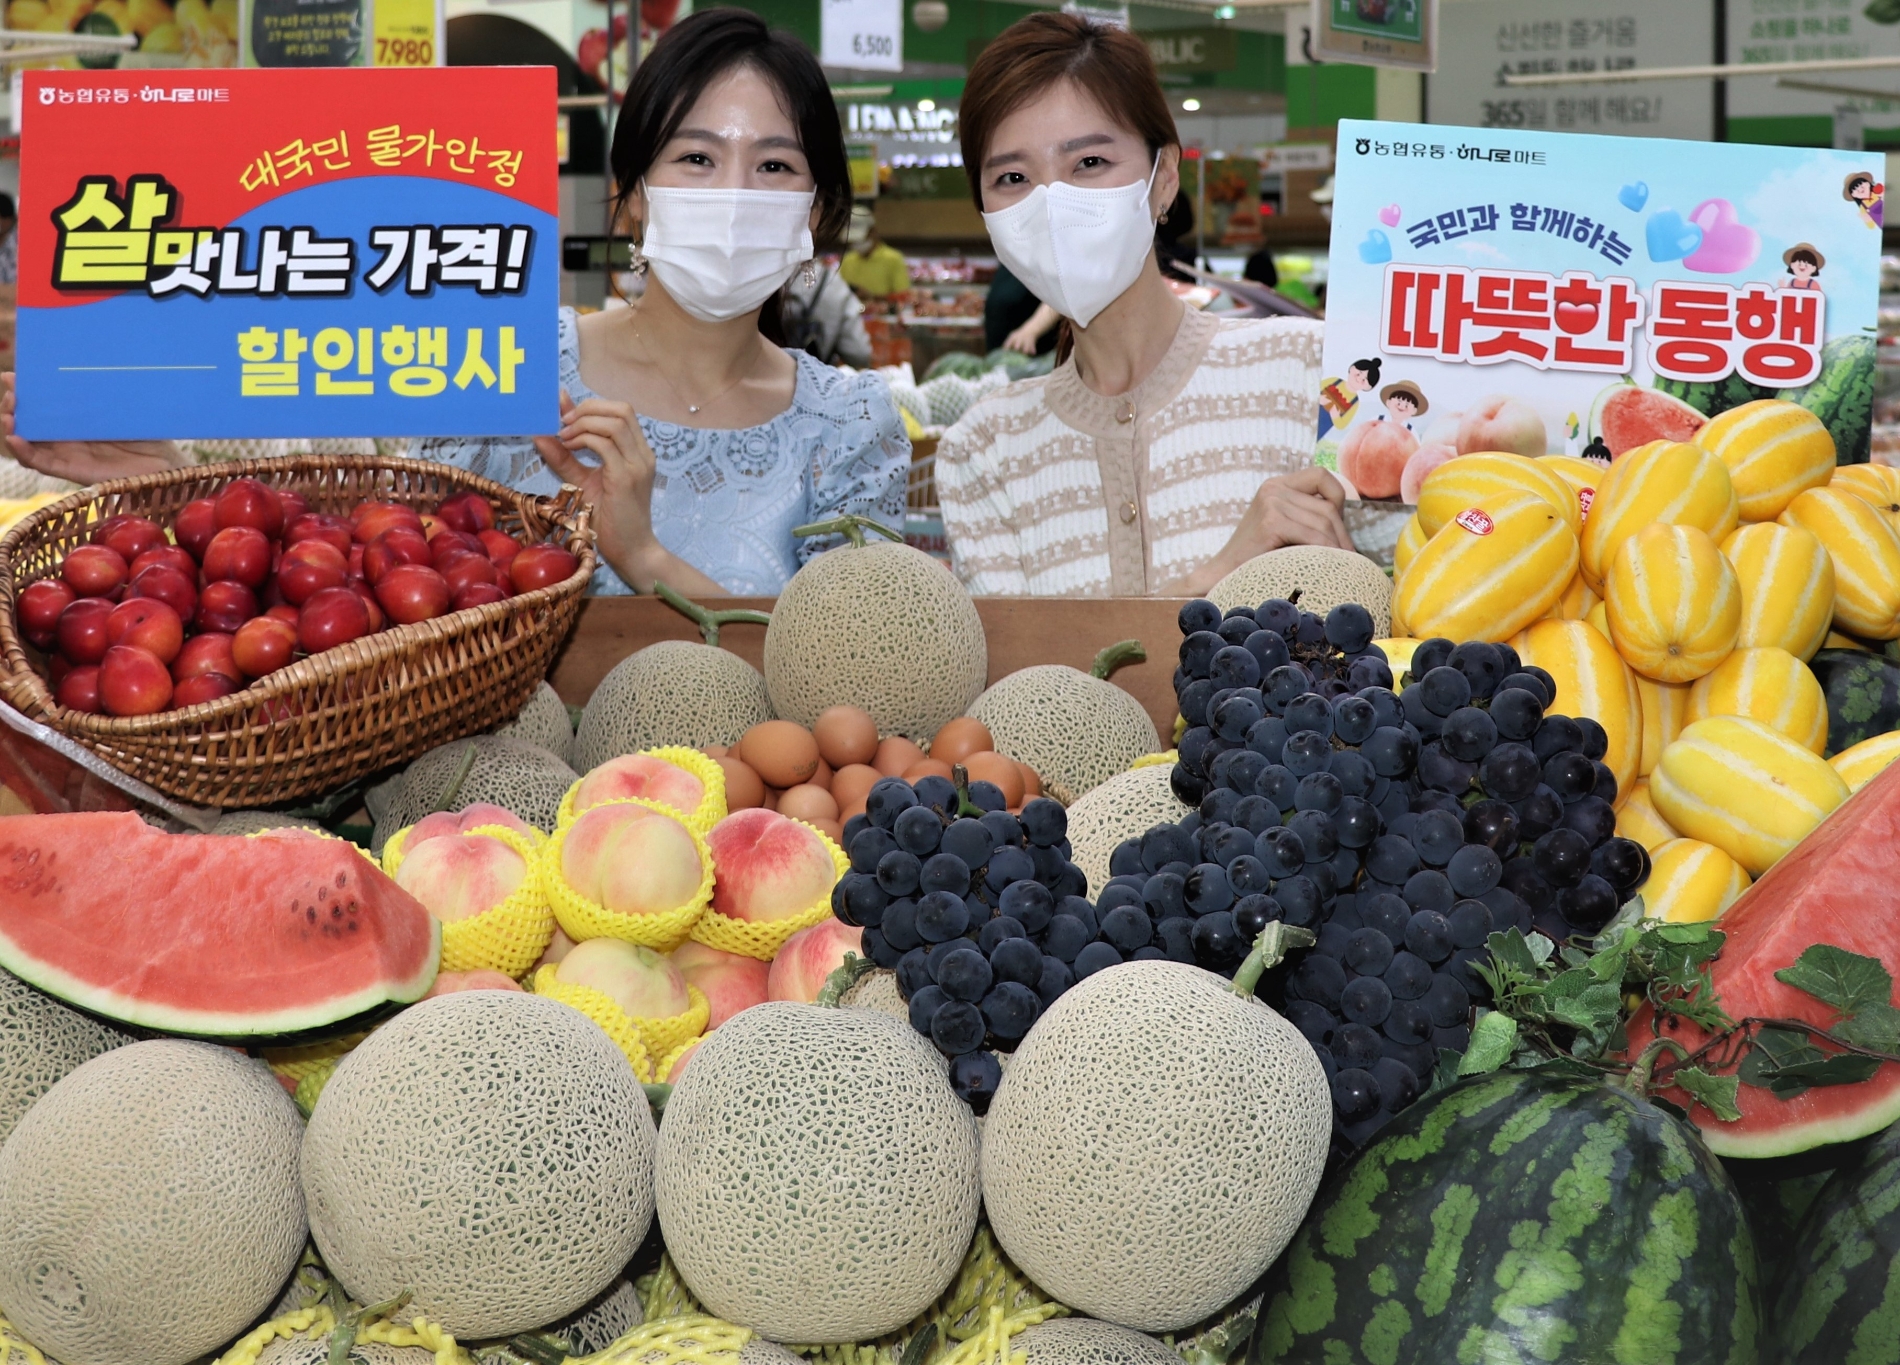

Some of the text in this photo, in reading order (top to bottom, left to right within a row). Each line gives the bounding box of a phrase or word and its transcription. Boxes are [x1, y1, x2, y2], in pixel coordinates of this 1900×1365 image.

[376, 38, 433, 65] 7,980
[853, 35, 893, 56] 6,500
[1497, 17, 1636, 51] 신선한 즐거움
[1481, 98, 1547, 127] 365일
[1554, 96, 1600, 127] 함께
[239, 124, 524, 192] 대국민 물가안정
[58, 180, 529, 295] 살맛나는 가격!
[1406, 203, 1633, 266] 국민과 함께하는
[1387, 270, 1818, 380] 따뜻한 동행
[237, 324, 525, 397] 할인행사
